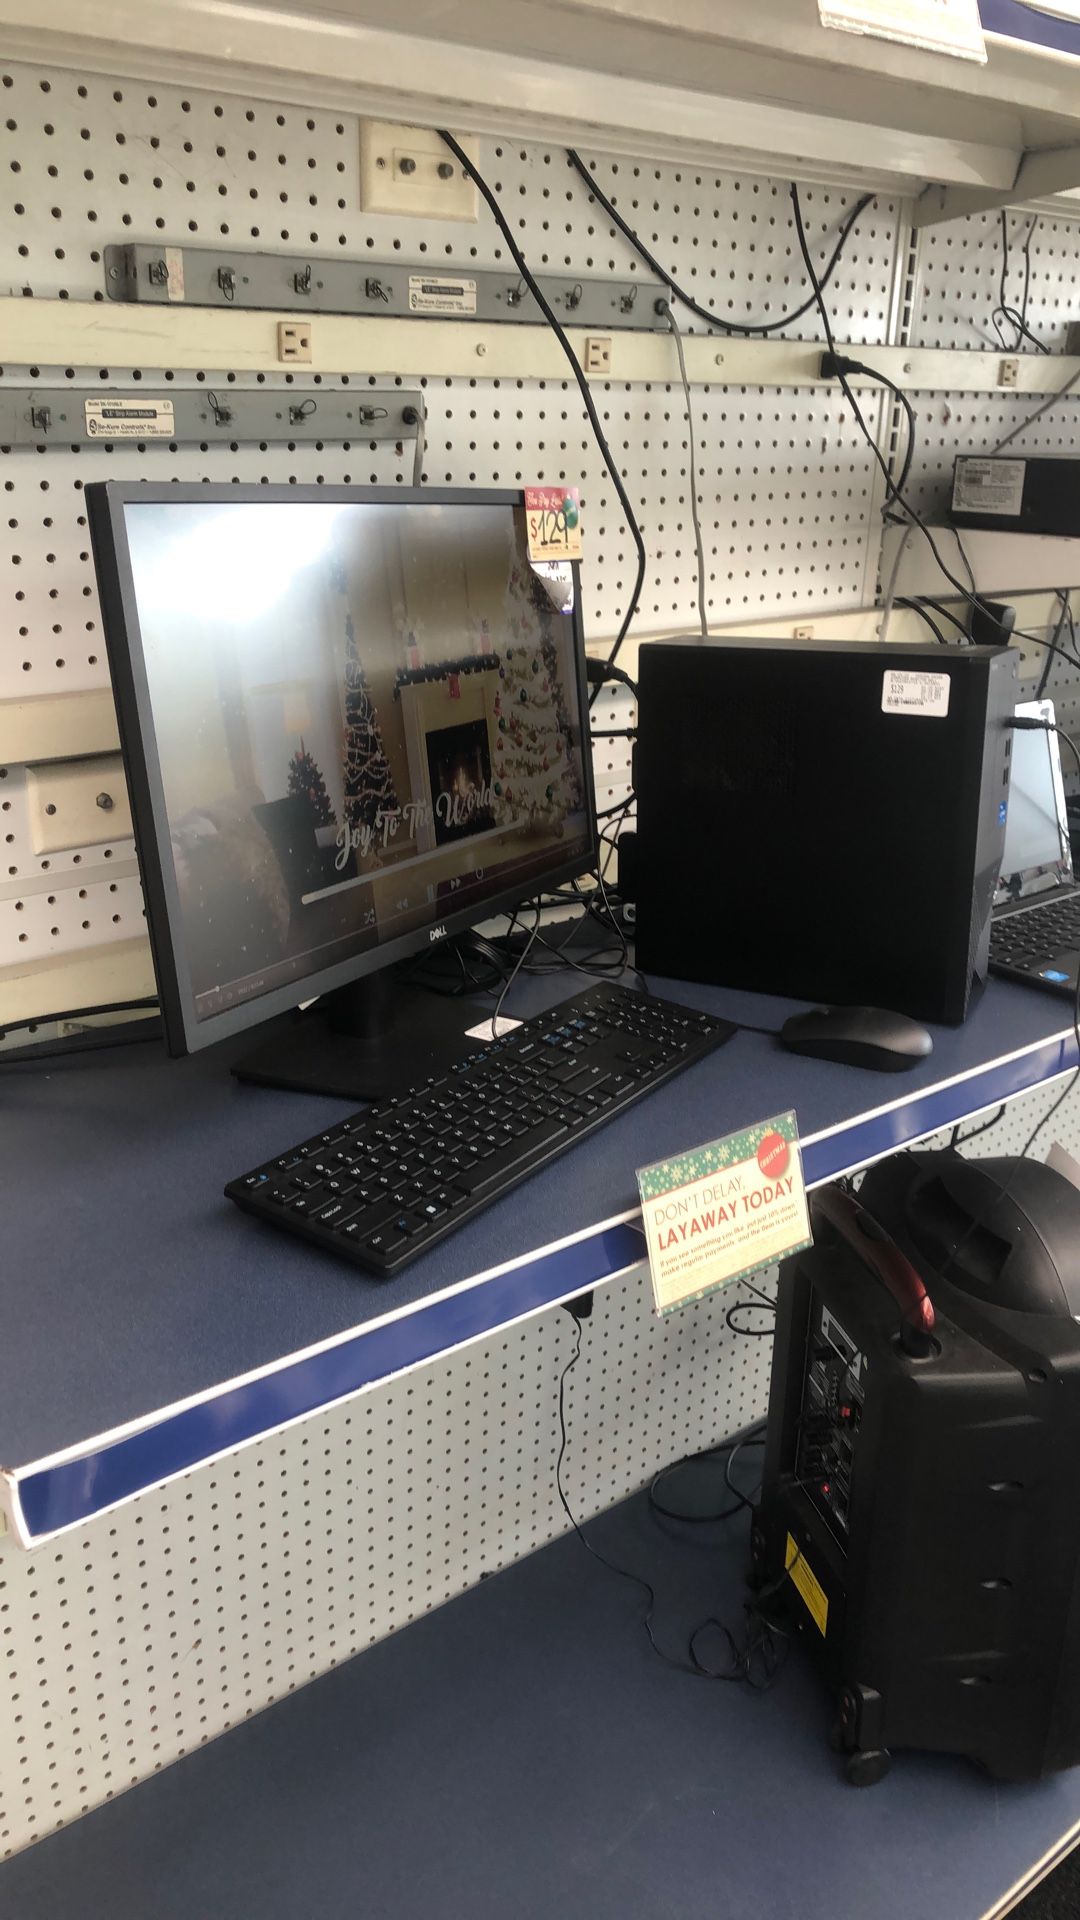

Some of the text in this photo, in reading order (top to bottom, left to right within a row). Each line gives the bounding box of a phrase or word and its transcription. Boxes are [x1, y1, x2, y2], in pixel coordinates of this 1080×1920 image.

[335, 777, 499, 871] Joy To The World
[430, 925, 447, 941] DELL
[655, 1193, 698, 1226] DON'T
[658, 1176, 793, 1251] LAYAWAY TODAY
[661, 1265, 680, 1278] make
[681, 1255, 704, 1271] regular
[738, 1233, 750, 1244] and
[750, 1228, 761, 1237] the
[761, 1222, 775, 1232] item
[666, 1255, 678, 1267] you
[679, 1250, 690, 1260] see
[691, 1236, 721, 1255] something
[722, 1231, 733, 1243] you
[747, 1220, 757, 1231] put
[757, 1214, 767, 1227] just
